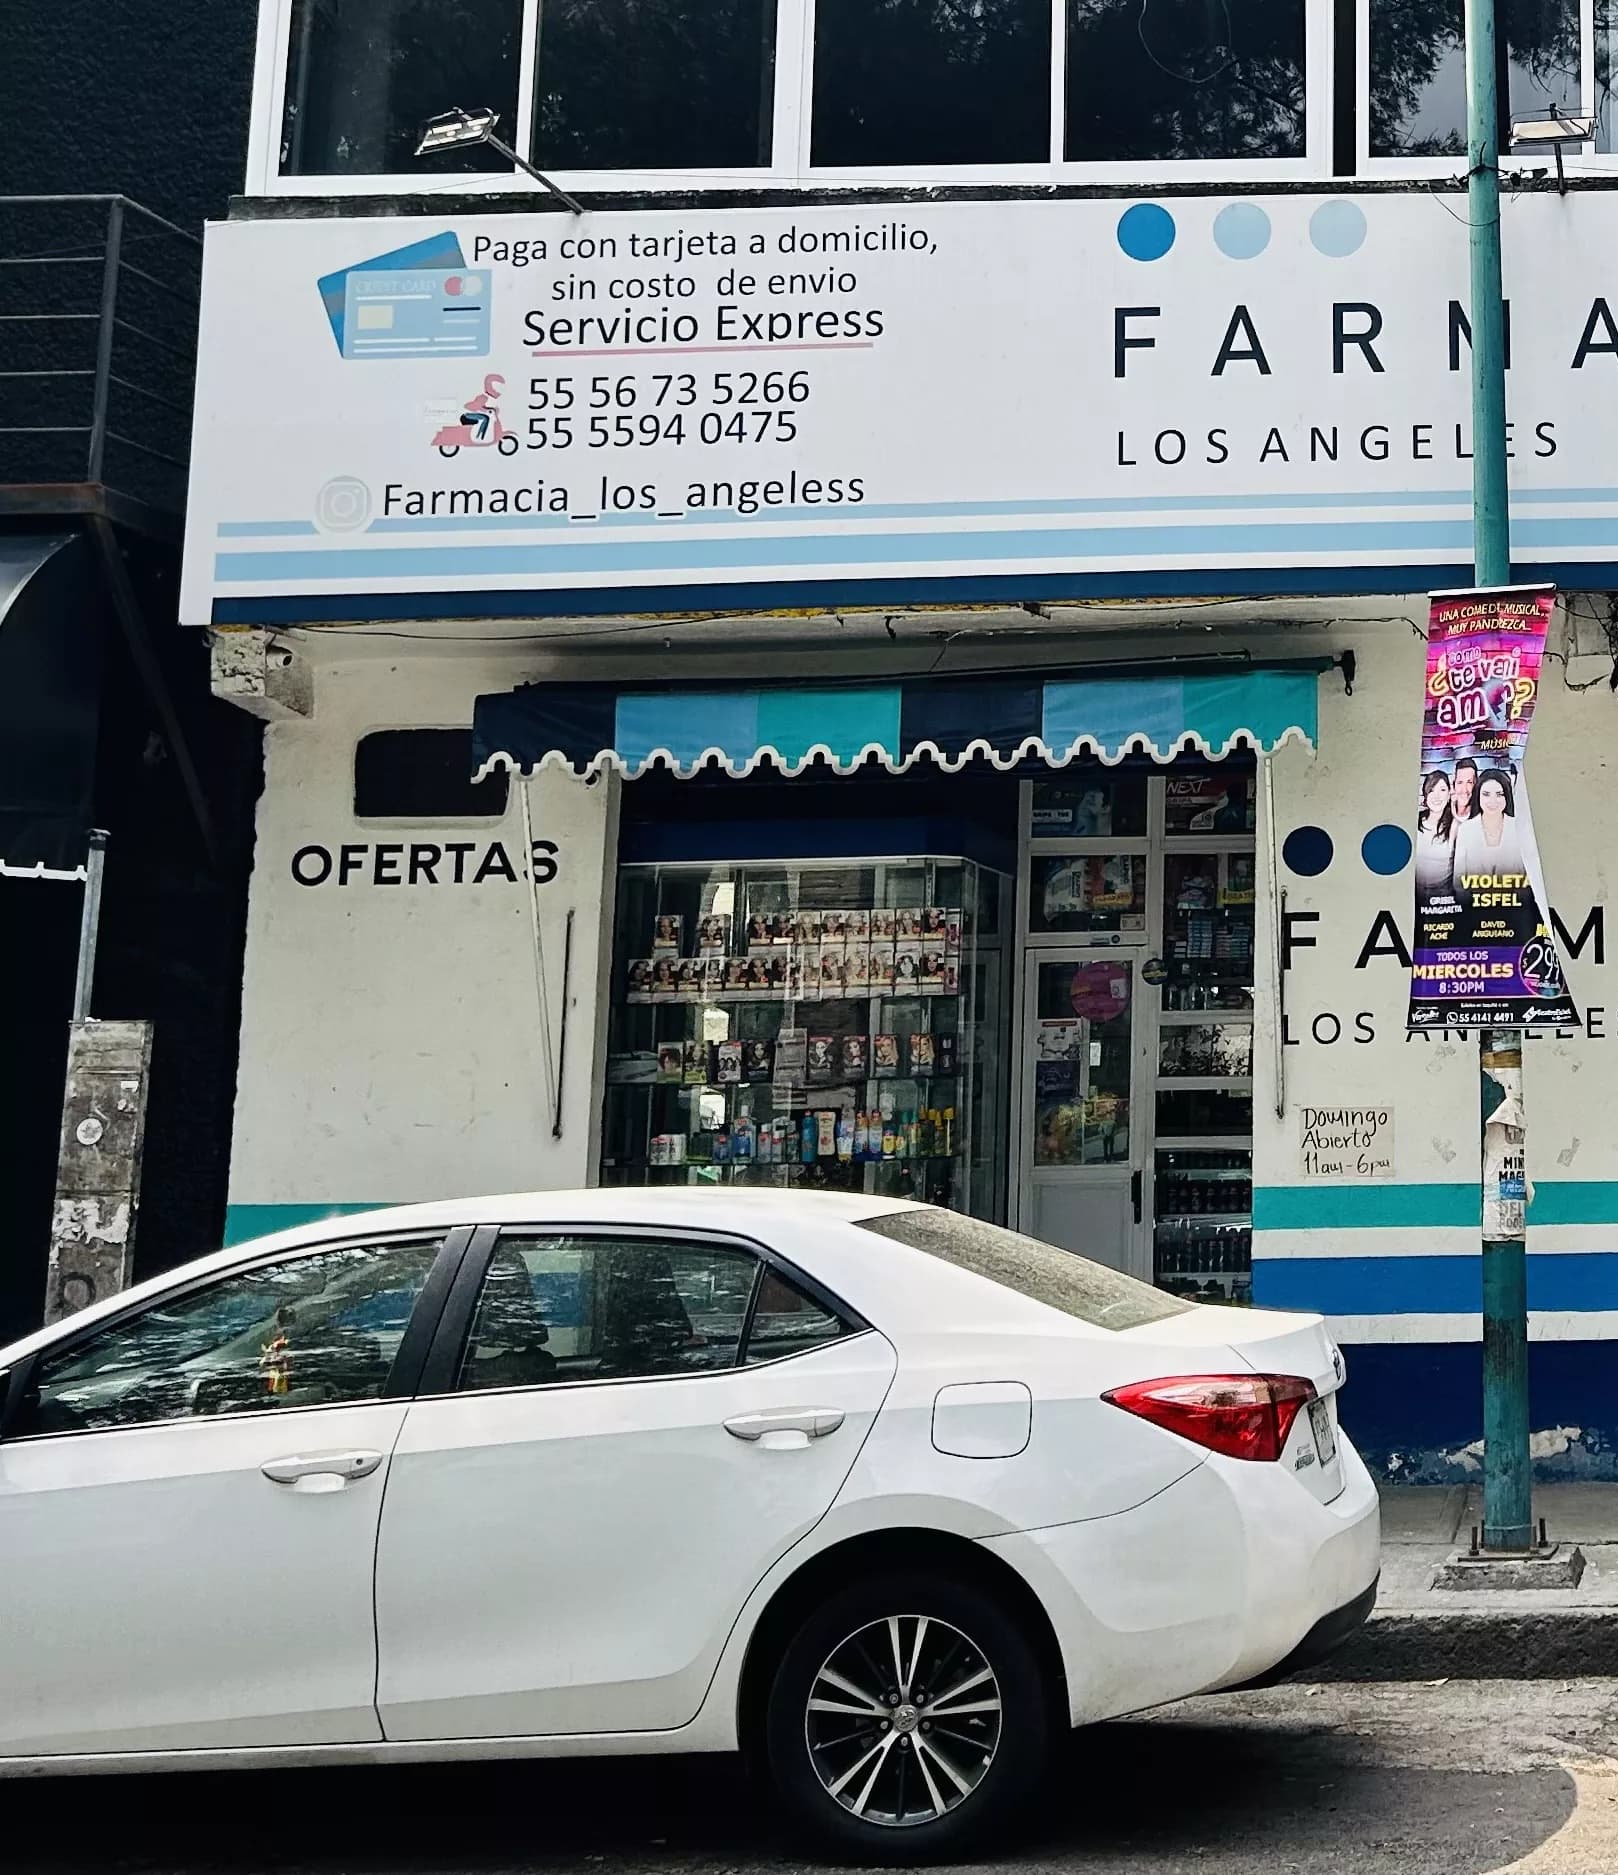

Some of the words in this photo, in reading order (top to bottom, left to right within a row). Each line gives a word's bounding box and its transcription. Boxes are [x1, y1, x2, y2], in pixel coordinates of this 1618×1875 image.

[474, 236, 547, 268] Paga
[560, 238, 616, 259] con
[628, 229, 736, 263] tarjeta
[749, 234, 765, 254] a
[778, 222, 937, 255] domicilio,
[551, 273, 596, 301] sin
[609, 273, 696, 299] costo
[717, 268, 756, 296] de
[768, 266, 857, 295] envio
[523, 306, 699, 346] Servicio
[717, 305, 884, 342] Express
[528, 377, 574, 410] 55
[589, 375, 636, 409] 56
[652, 374, 697, 407] 73
[712, 370, 810, 405] 5266
[526, 417, 573, 450] 55
[588, 413, 686, 448] 5594
[700, 410, 797, 445] 0475
[1118, 428, 1229, 466] LOS
[384, 470, 864, 520] Farmacia_los_angeless
[1440, 608, 1459, 622] UNA
[1448, 622, 1469, 635] MUY
[1167, 778, 1211, 795] NEXT
[291, 840, 559, 886] OFERTAS
[1461, 874, 1531, 889] VIOLETA
[1472, 893, 1522, 907] ISFEL
[1481, 921, 1506, 929] DAVID
[1436, 951, 1467, 961] TODOS
[1470, 951, 1489, 961] LOS
[1413, 963, 1514, 980] MIERCOLES
[1439, 981, 1485, 994] 8:30PM
[1283, 1012, 1375, 1045] LOS
[1459, 1014, 1470, 1023] 55
[1302, 1108, 1388, 1136] Domingo
[1302, 1128, 1371, 1149] Abierto
